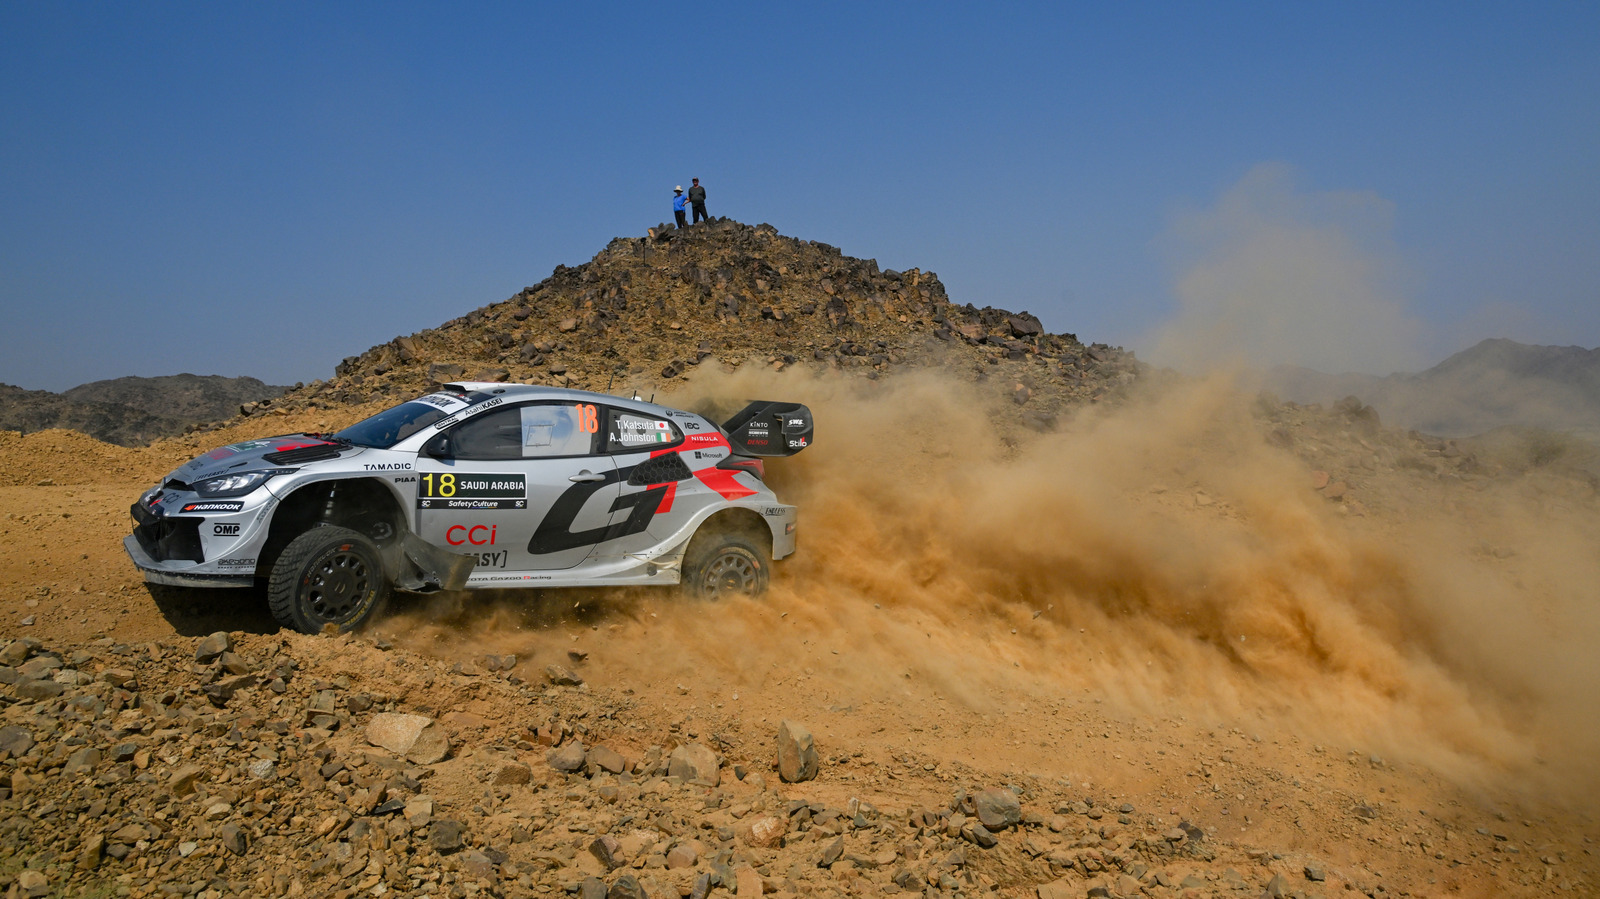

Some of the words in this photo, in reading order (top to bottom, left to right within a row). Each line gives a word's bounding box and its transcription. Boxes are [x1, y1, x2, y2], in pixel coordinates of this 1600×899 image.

[575, 403, 599, 434] 18
[616, 419, 655, 430] T.Katsuta
[609, 432, 657, 442] A.Johnston
[789, 436, 808, 447] Stilo
[364, 462, 412, 471] TAMADIC
[394, 476, 417, 484] PIAA
[422, 473, 457, 498] 18
[460, 480, 489, 490] SAUDI
[490, 480, 525, 490] ARABIA
[448, 500, 499, 509] SafetyCulture
[213, 524, 241, 535] OMP
[446, 524, 497, 546] CCi
